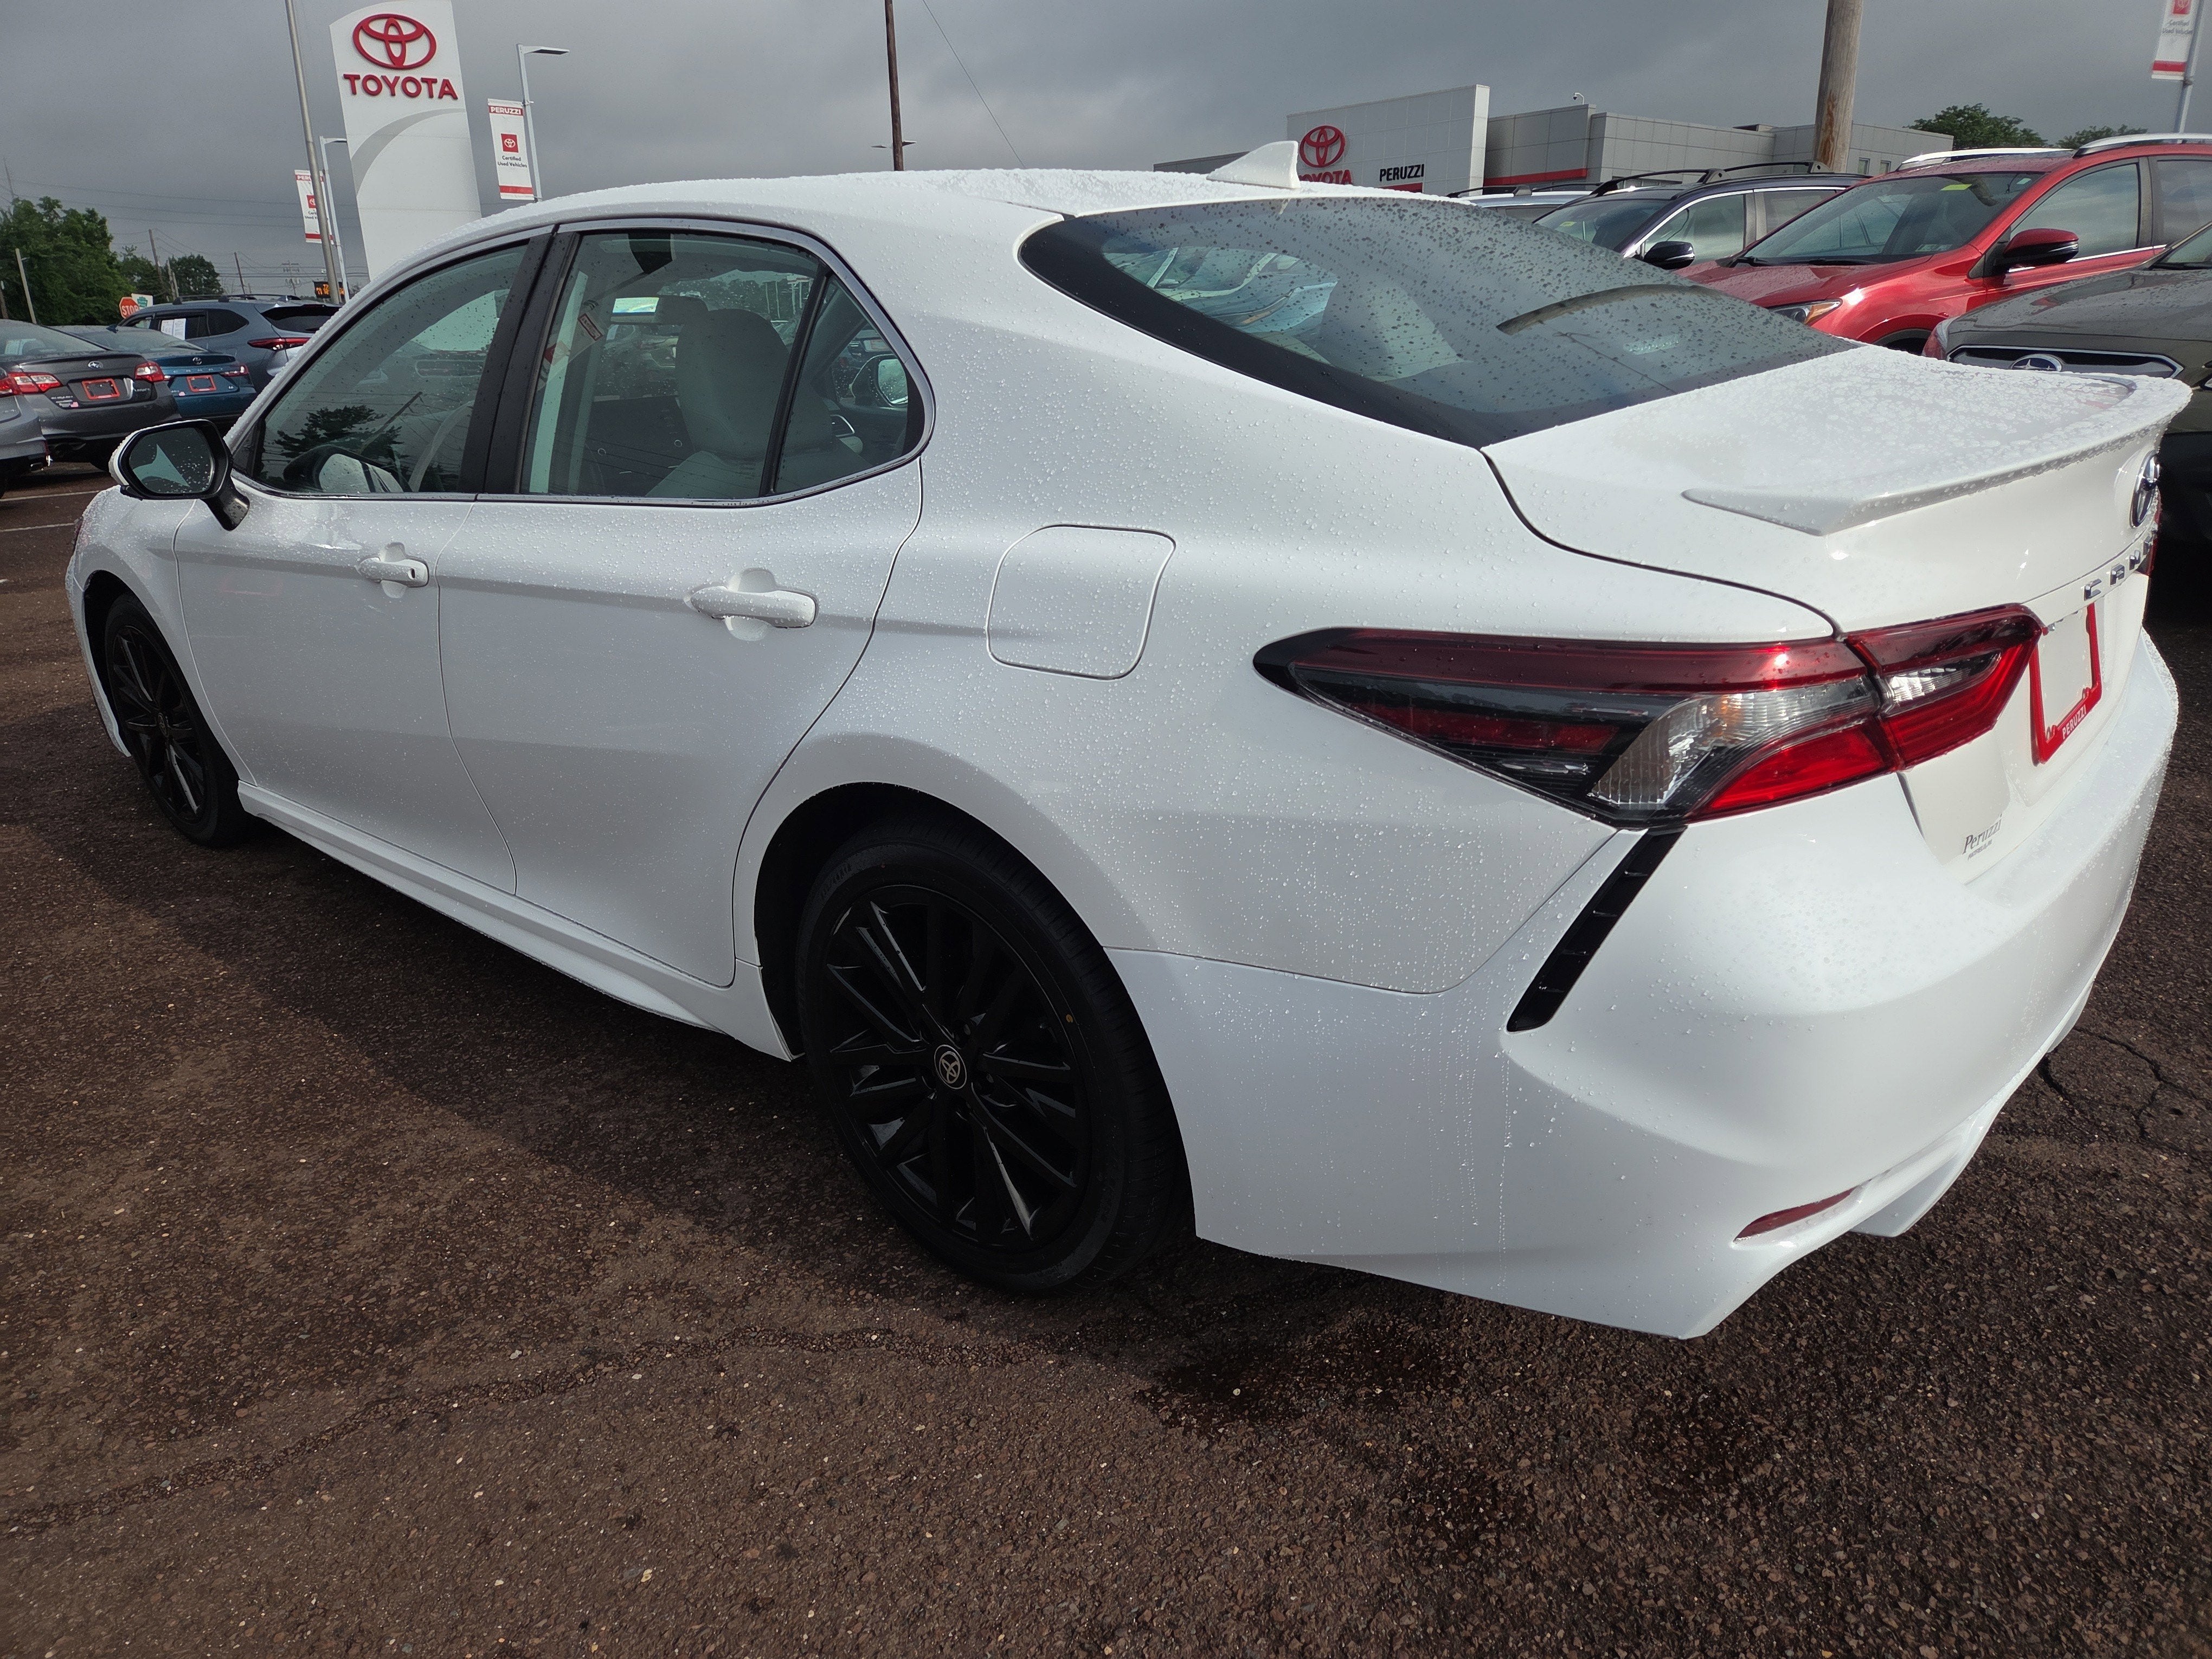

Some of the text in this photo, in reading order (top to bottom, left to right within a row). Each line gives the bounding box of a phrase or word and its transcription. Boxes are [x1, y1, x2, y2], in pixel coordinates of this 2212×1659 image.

[343, 74, 458, 100] TOYOTA
[490, 106, 521, 115] PERUZZI
[1379, 164, 1425, 182] PERUZZI
[121, 305, 139, 316] STOP
[2062, 704, 2086, 740] PERUZZI
[1963, 813, 2003, 855] Peruzzi
